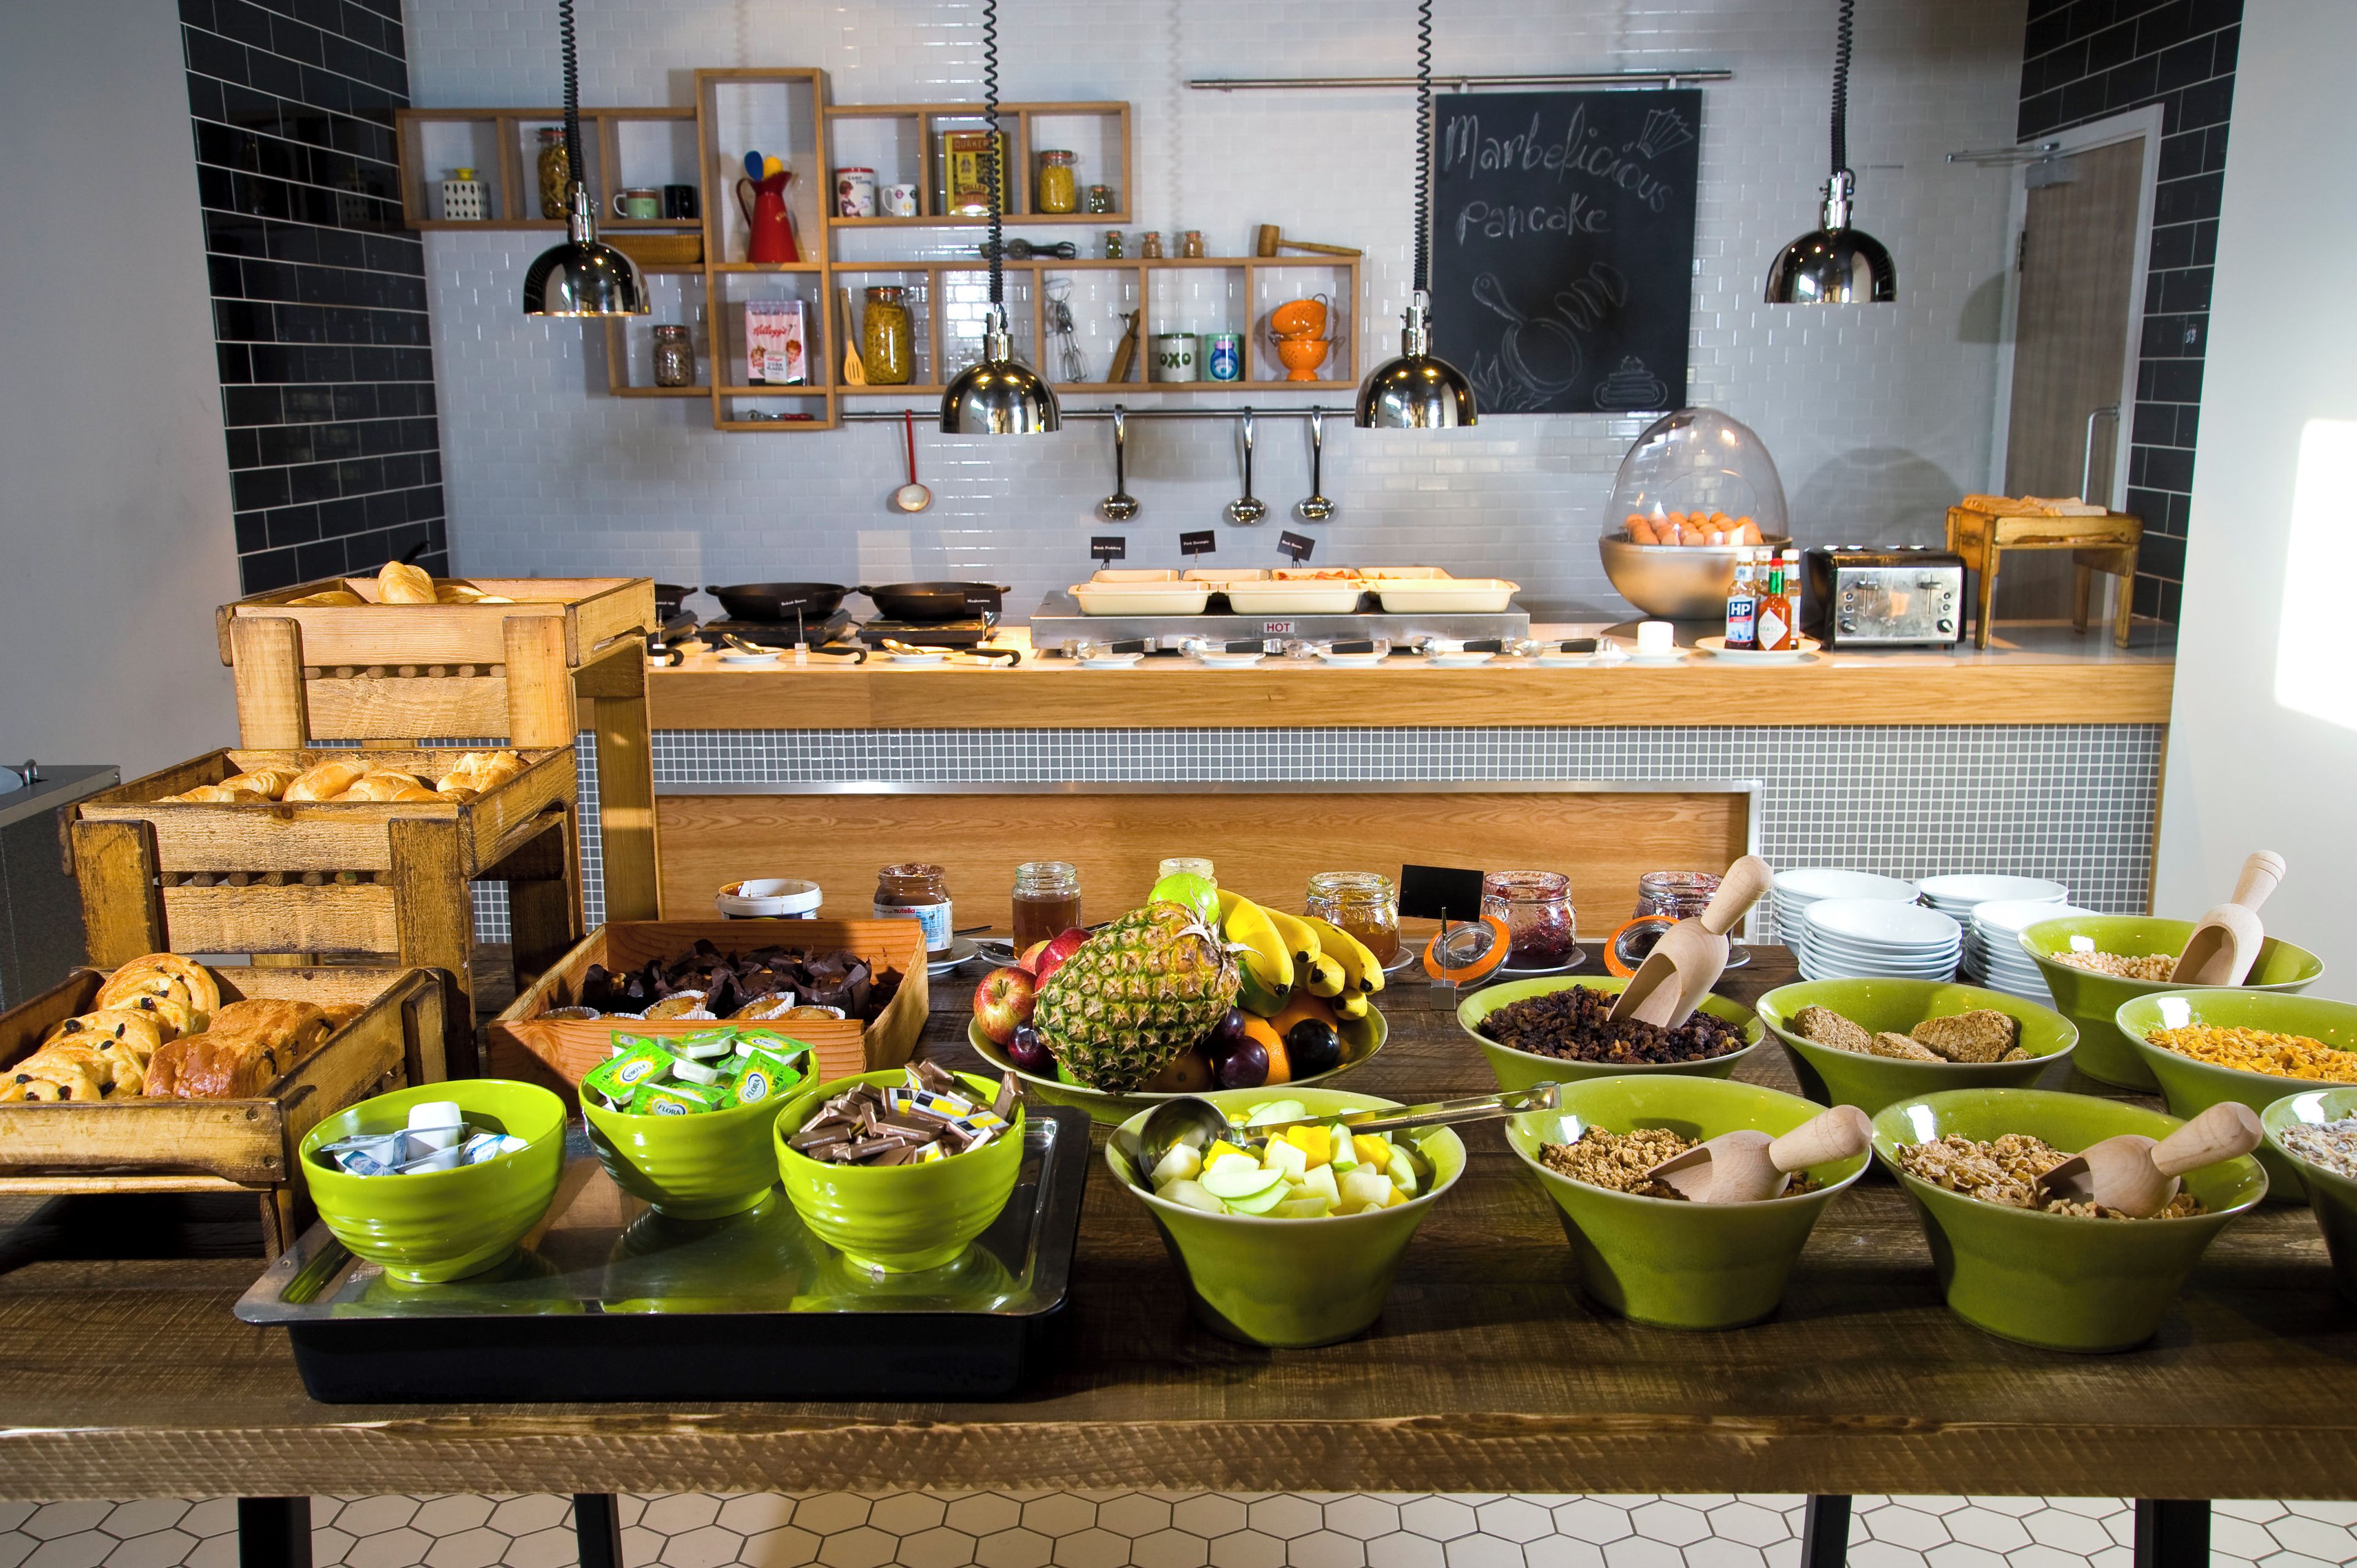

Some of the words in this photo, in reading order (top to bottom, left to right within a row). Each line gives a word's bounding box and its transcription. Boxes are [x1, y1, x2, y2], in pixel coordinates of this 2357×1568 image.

[1160, 352, 1192, 369] OXO
[1731, 603, 1751, 616] HP
[1266, 623, 1291, 632] HOT
[746, 1079, 761, 1099] FLORA
[657, 1104, 681, 1116] FLORA
